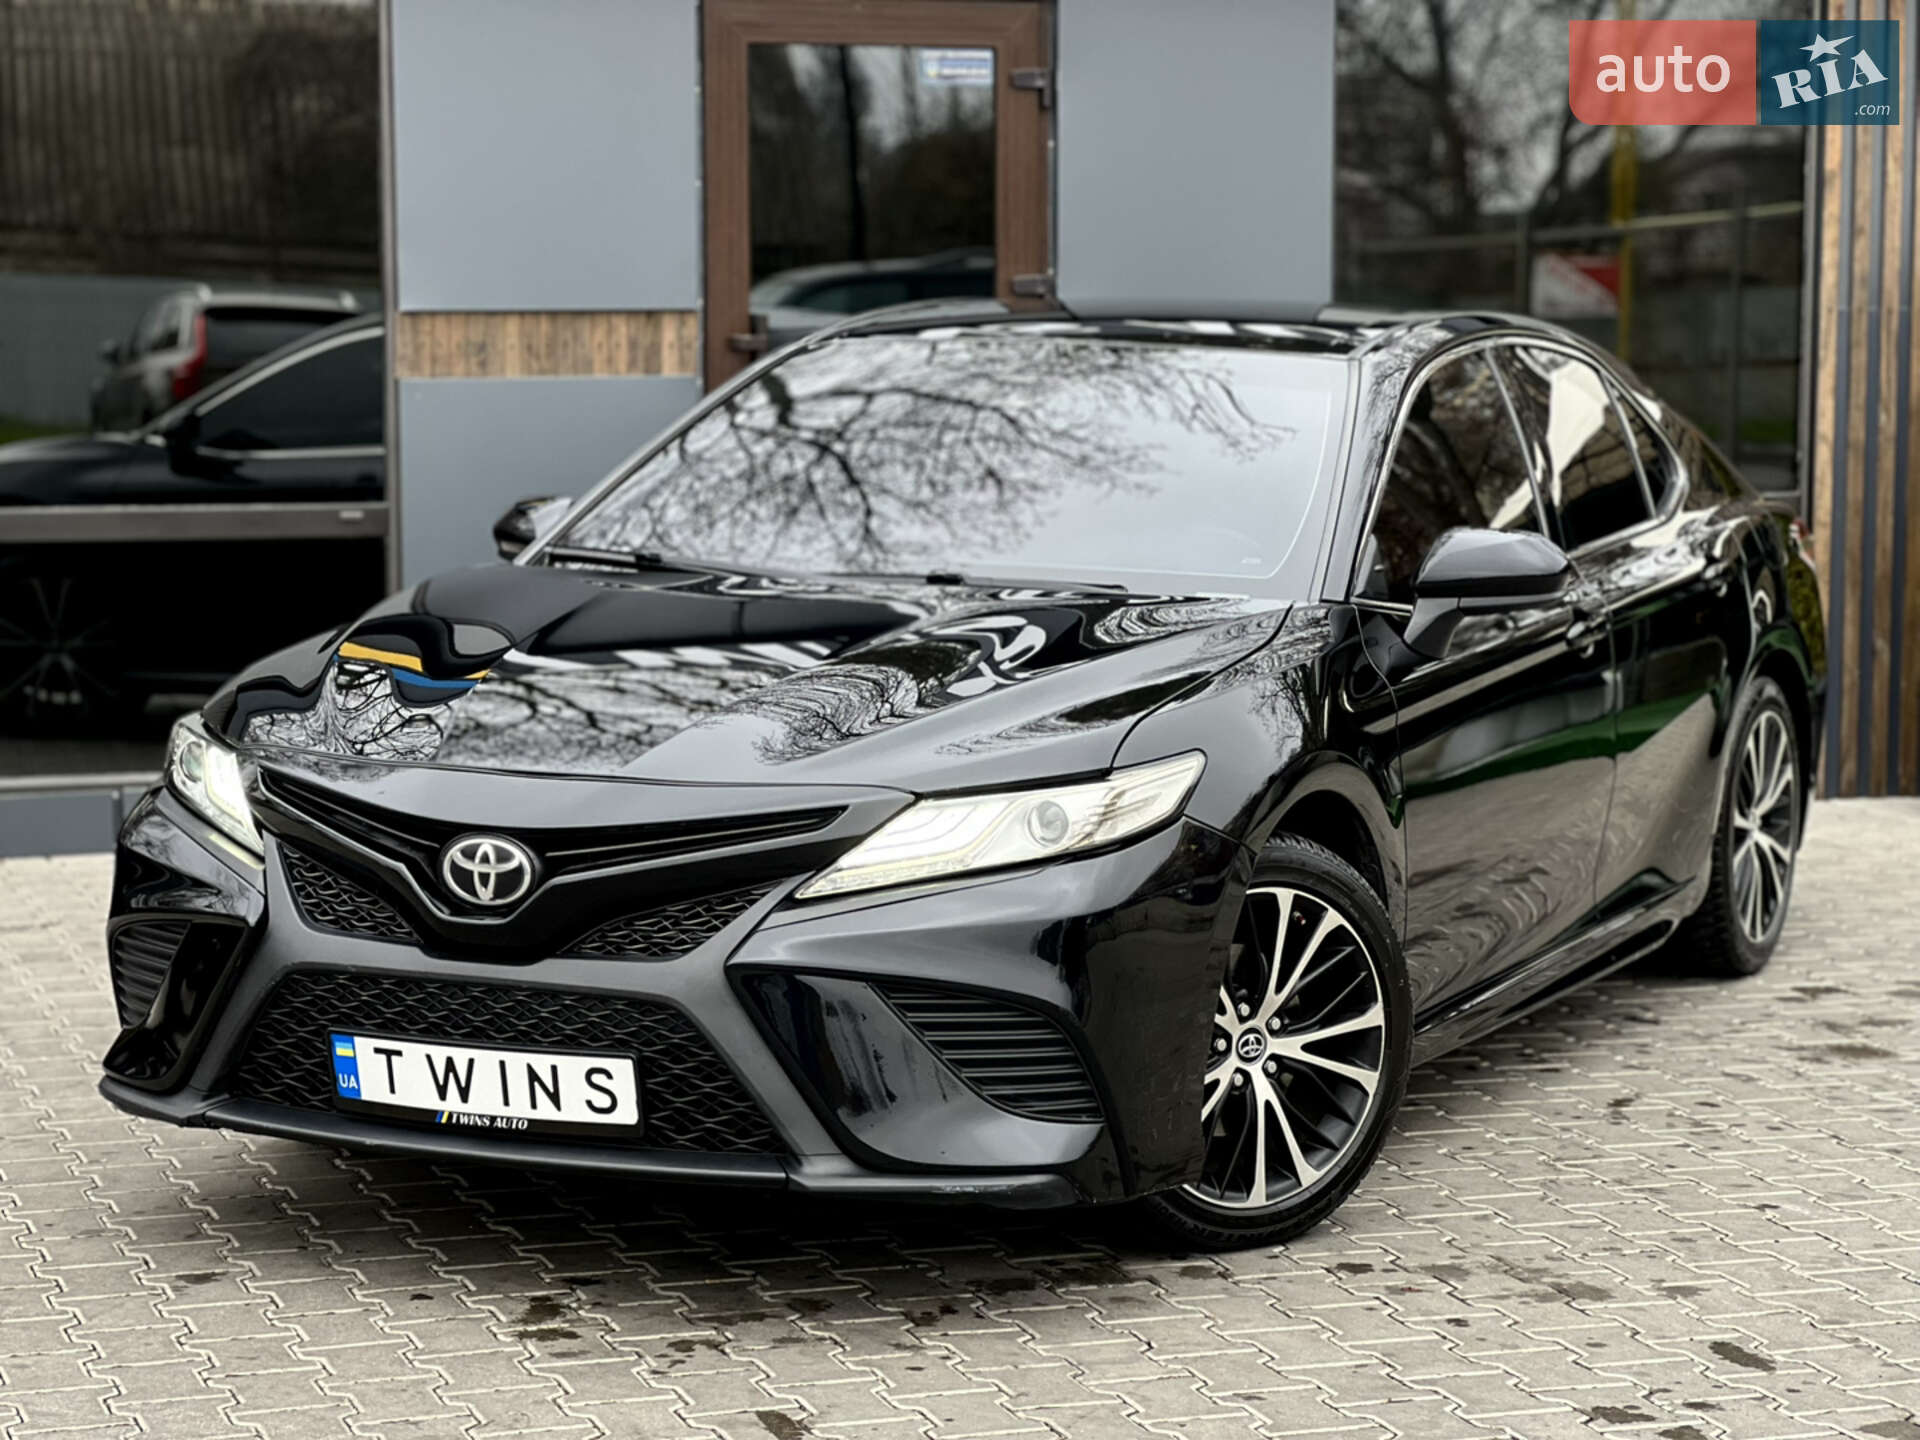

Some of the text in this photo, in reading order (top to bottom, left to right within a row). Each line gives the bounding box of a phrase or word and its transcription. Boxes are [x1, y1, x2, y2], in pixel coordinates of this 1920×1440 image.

[338, 1073, 358, 1090] UA
[373, 1046, 619, 1115] TWINS
[451, 1112, 529, 1130] TWINS AUTO
